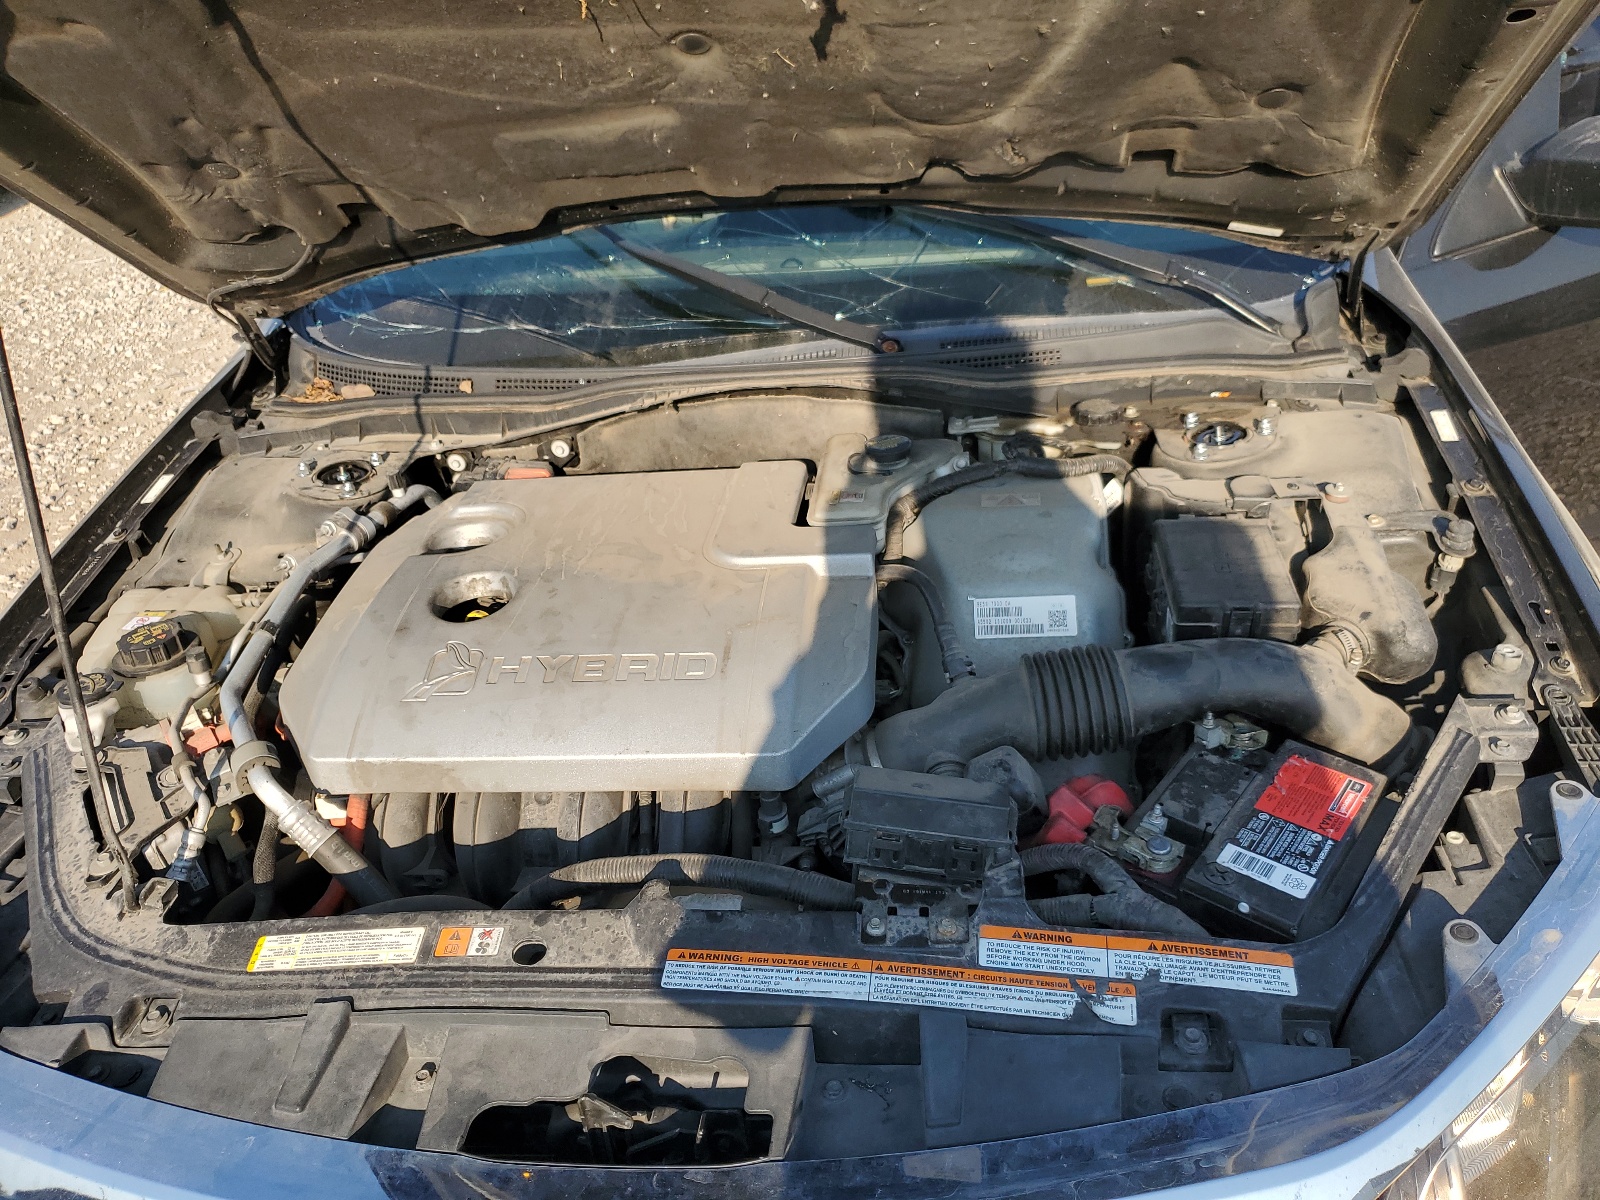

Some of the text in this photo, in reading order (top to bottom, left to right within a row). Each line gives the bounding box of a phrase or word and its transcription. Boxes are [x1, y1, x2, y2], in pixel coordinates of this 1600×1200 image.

[486, 652, 718, 684] HYBRID
[1317, 813, 1334, 832] MAX
[1023, 932, 1072, 943] WARNING
[689, 952, 742, 962] WARNING:
[1161, 943, 1248, 960] AVERTISSEMENT
[887, 965, 965, 978] AVERTISSEMENT
[973, 974, 1006, 983] CIRCUITS
